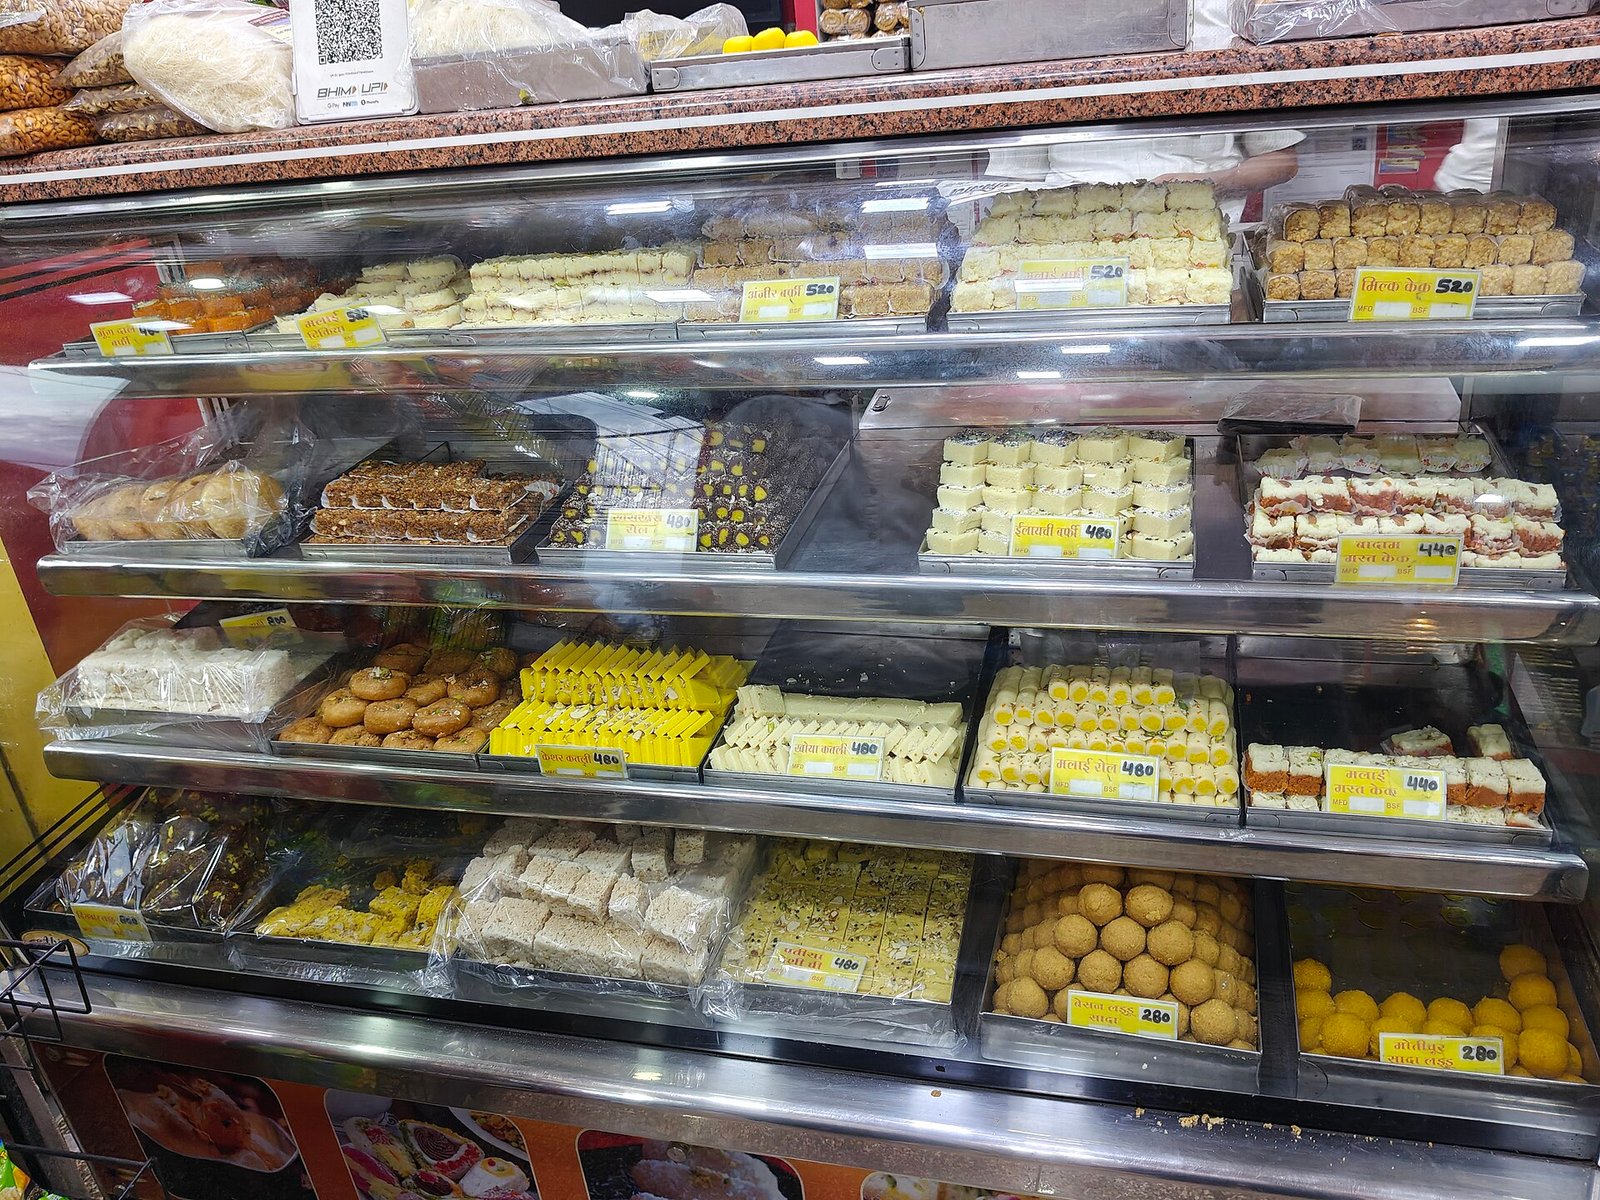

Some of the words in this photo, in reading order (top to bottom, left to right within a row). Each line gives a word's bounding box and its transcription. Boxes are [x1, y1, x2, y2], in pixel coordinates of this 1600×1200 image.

[317, 86, 352, 98] BHIM
[361, 82, 384, 94] UPI
[1090, 265, 1123, 279] 520
[747, 286, 777, 299] अंजीर
[805, 283, 835, 297] 520
[1361, 276, 1400, 292] मिल्क
[1404, 278, 1431, 293] केक
[1435, 278, 1473, 294] 520
[666, 513, 691, 529] 480
[1085, 524, 1112, 540] 480
[1355, 540, 1401, 550] बादाम
[1419, 542, 1457, 557] 440
[1381, 552, 1410, 563] केक
[851, 741, 878, 755] 480
[593, 752, 619, 765] 480
[1056, 757, 1093, 774] मलाई
[1094, 758, 1117, 774] रोल
[1121, 760, 1154, 777] 480
[1345, 768, 1388, 782] मलाई
[1406, 775, 1438, 792] 440
[1334, 783, 1364, 794] मस्त
[1369, 783, 1397, 796] केक
[834, 957, 859, 971] 480
[1141, 1008, 1171, 1024] 280
[1462, 1045, 1497, 1062] 280
